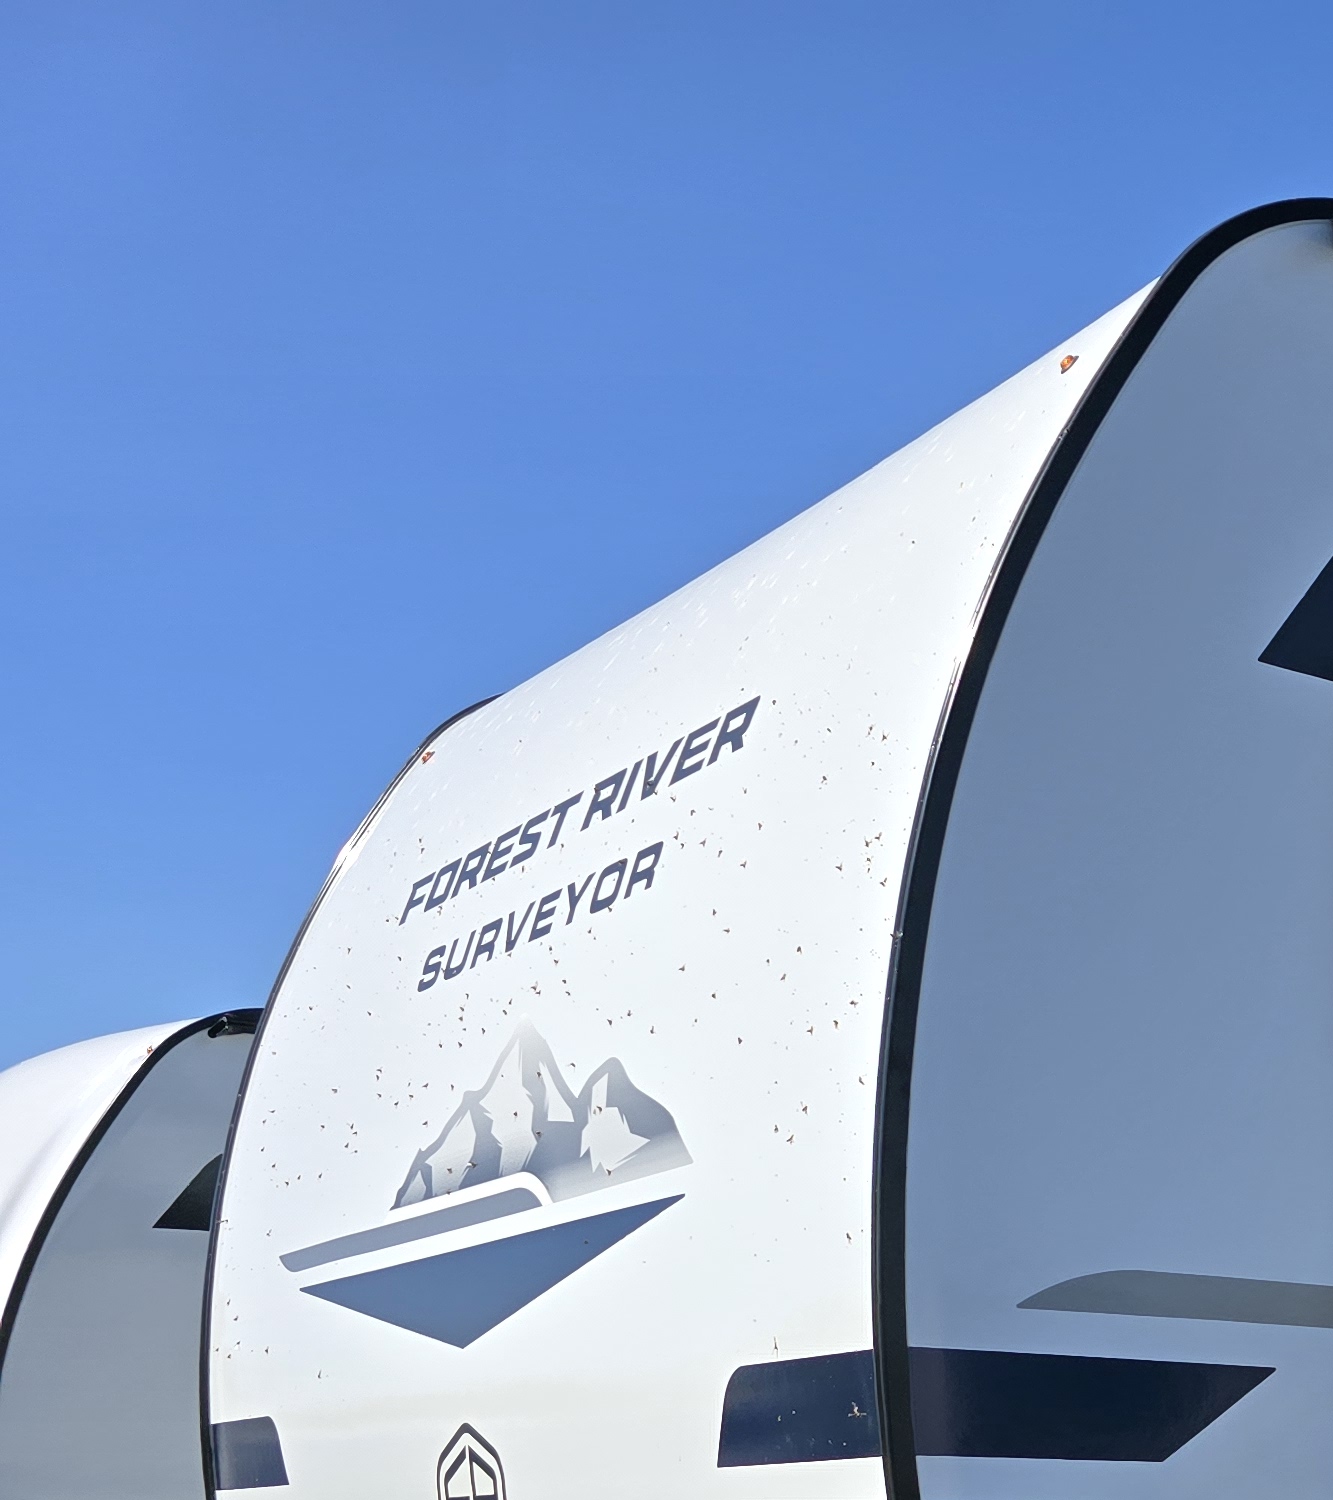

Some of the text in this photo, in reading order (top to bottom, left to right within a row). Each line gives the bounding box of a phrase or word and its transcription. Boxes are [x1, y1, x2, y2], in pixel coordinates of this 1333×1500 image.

[399, 694, 761, 927] FOREST RIVER
[417, 840, 664, 992] SURVEYOR
